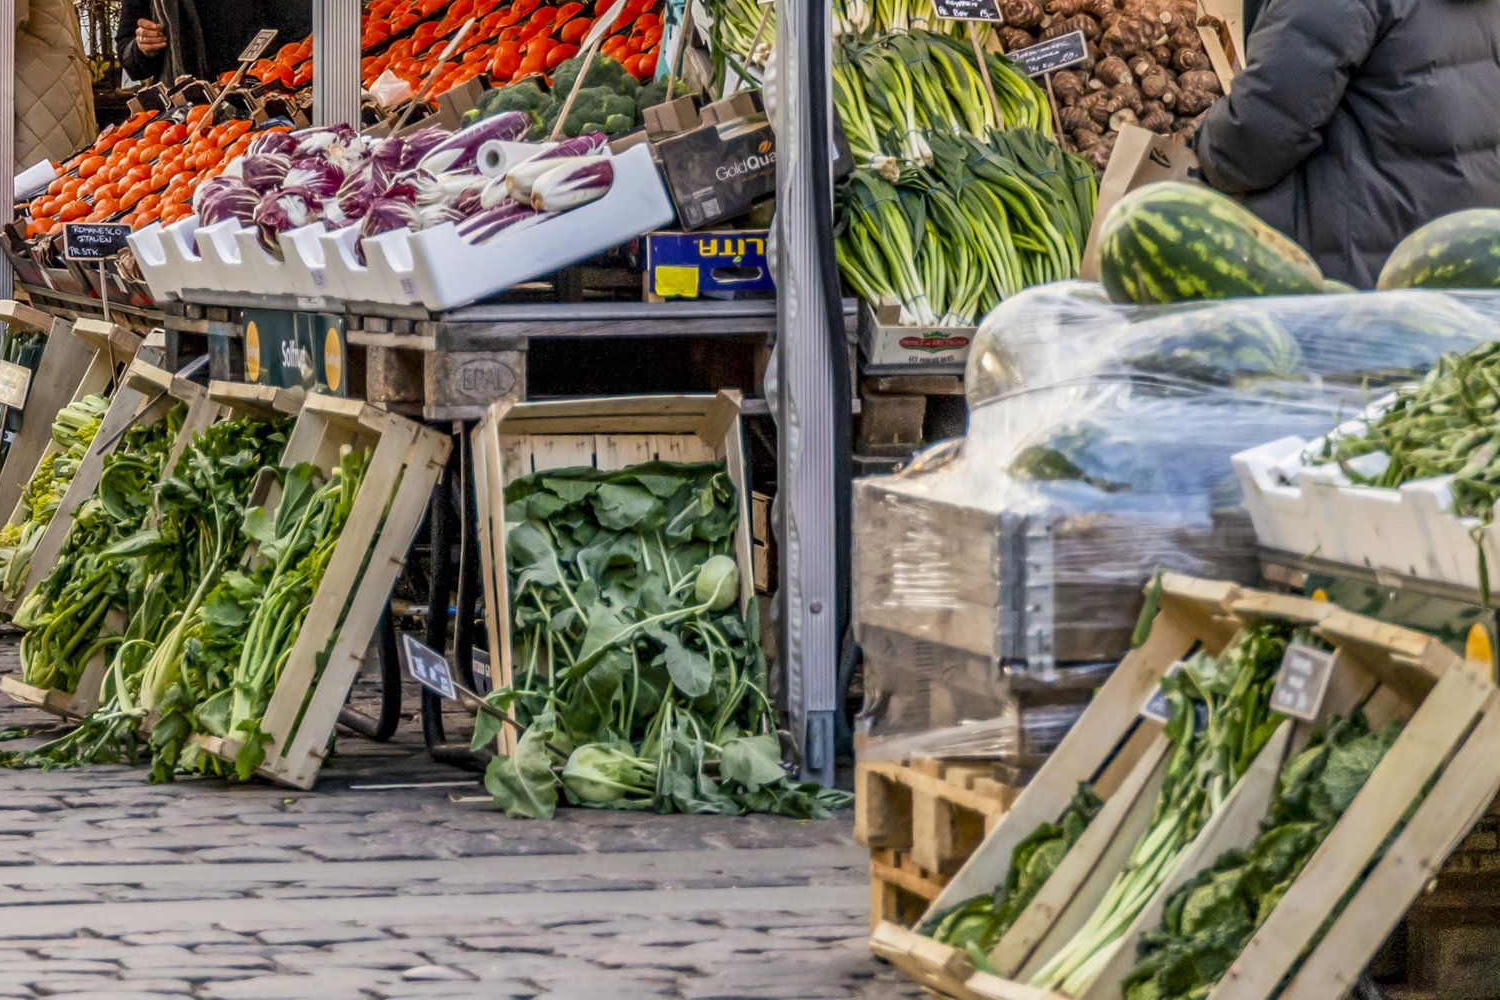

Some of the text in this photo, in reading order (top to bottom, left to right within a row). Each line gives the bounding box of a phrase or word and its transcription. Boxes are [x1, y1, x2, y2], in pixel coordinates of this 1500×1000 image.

[71, 225, 122, 235] ROMANESCO
[76, 235, 112, 243] ITALIEN
[699, 238, 769, 257] LITA
[462, 367, 507, 391] EPAL
